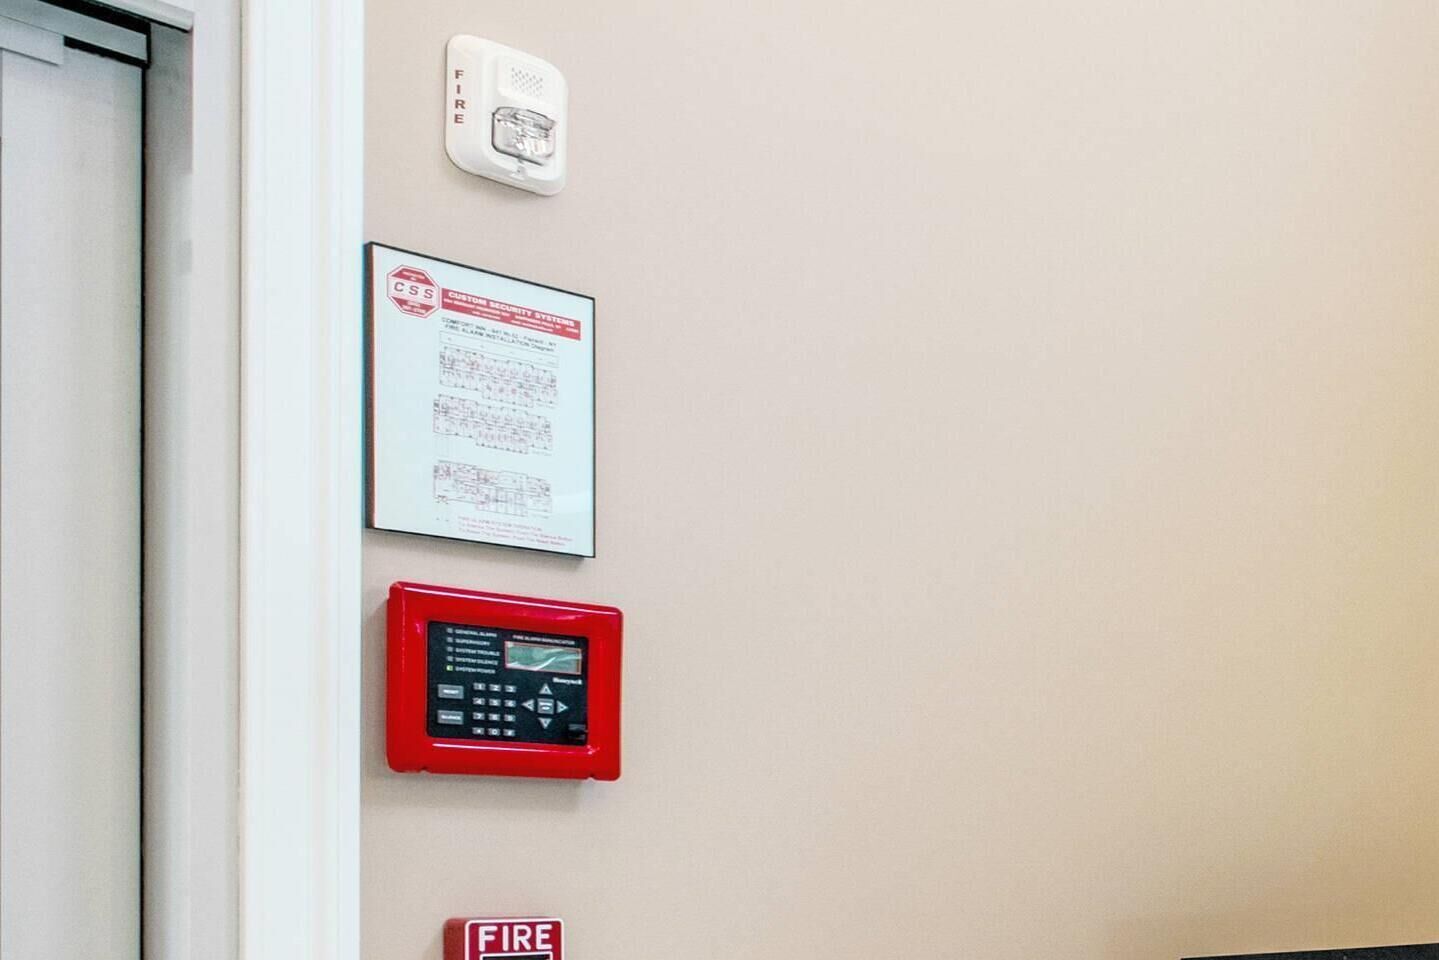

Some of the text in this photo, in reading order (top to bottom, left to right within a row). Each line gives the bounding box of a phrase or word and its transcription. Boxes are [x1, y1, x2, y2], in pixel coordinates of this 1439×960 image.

[454, 69, 466, 124] FIRE
[448, 291, 487, 305] CUSTOM
[489, 301, 532, 317] SECURITY
[535, 311, 575, 327] SYSTEMS
[455, 647, 477, 655] SYSTEM
[455, 656, 478, 664] SYSTEM
[552, 677, 583, 685] Honeywell
[478, 924, 553, 952] FIRE
